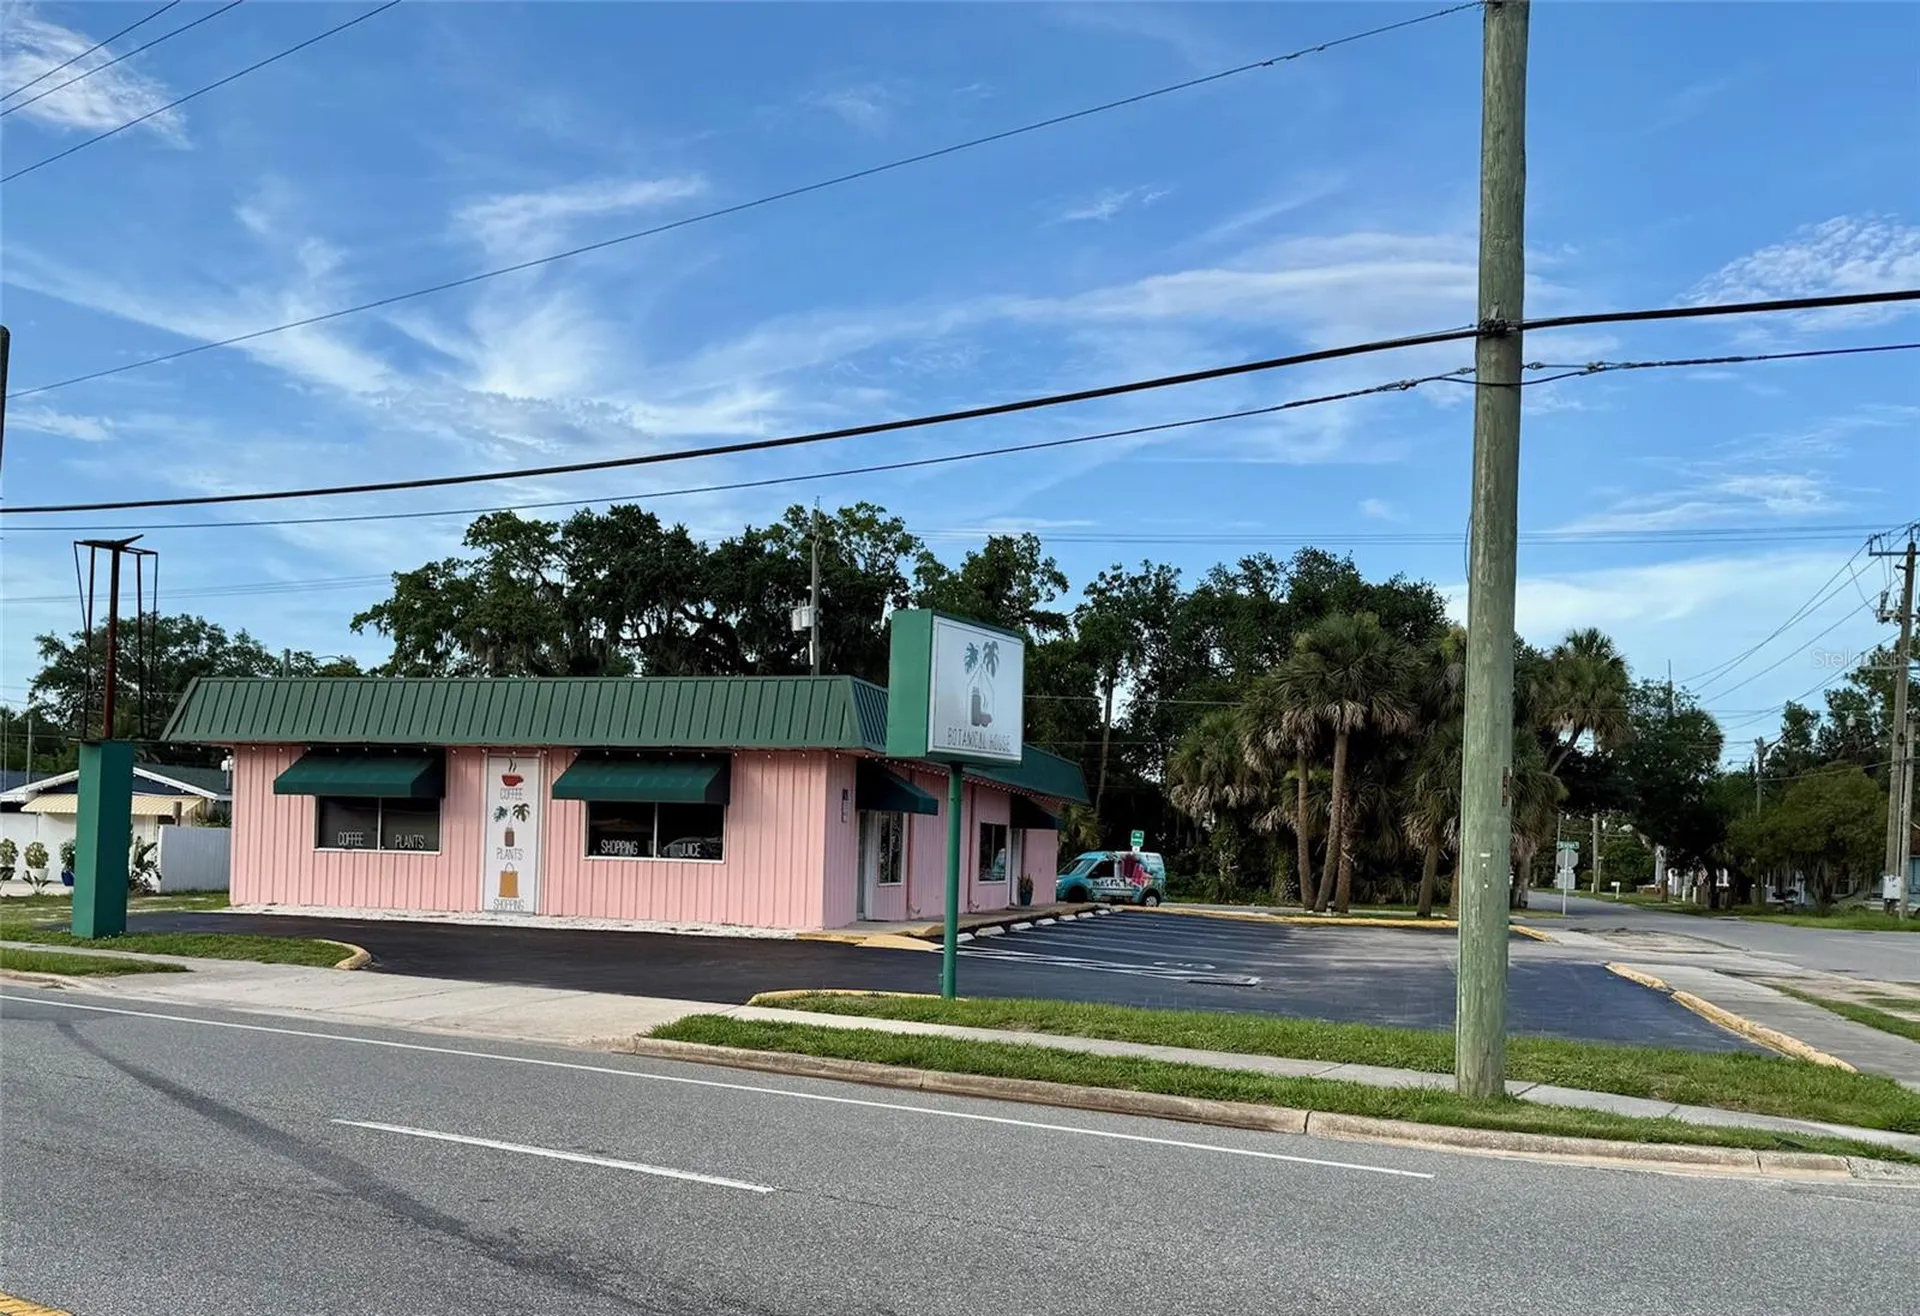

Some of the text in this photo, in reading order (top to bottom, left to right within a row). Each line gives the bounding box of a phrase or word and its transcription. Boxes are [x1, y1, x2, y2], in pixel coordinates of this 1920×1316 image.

[947, 727, 987, 749] BOTANICAL
[500, 787, 524, 800] COFFEE
[337, 831, 364, 847] COFFEE
[394, 834, 425, 849] PLANTS
[496, 847, 525, 861] PLANTS
[601, 839, 639, 855] SHOPPING
[680, 842, 701, 857] JUICE
[493, 899, 525, 911] SHOPPING
